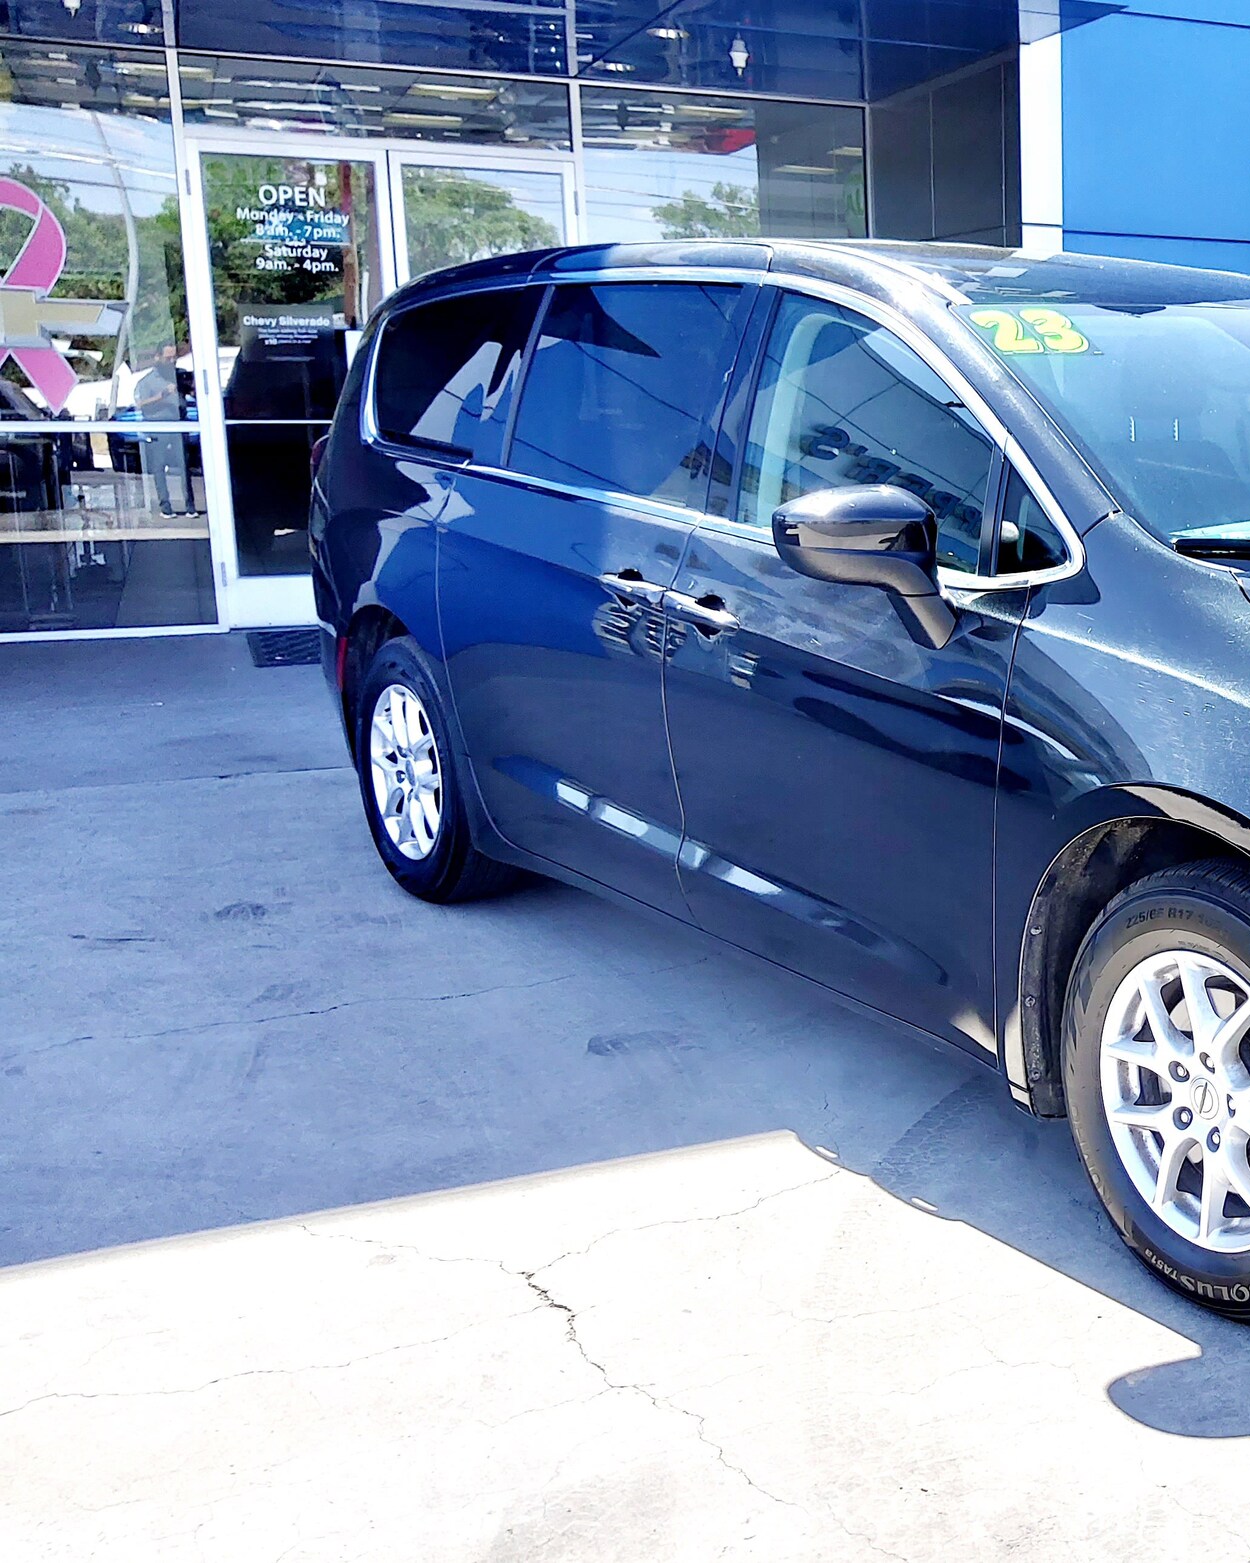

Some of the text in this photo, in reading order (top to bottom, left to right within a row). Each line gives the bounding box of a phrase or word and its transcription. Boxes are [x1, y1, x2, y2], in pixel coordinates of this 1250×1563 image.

[258, 184, 326, 207] OPEN
[236, 207, 294, 224] Monday
[306, 211, 349, 226] Friday
[304, 225, 341, 240] 7pm.
[264, 244, 328, 260] Saturday
[255, 257, 292, 271] 9am.
[302, 259, 339, 273] 4pm.
[243, 315, 330, 327] Chevy Silverado
[968, 308, 1090, 354] 23
